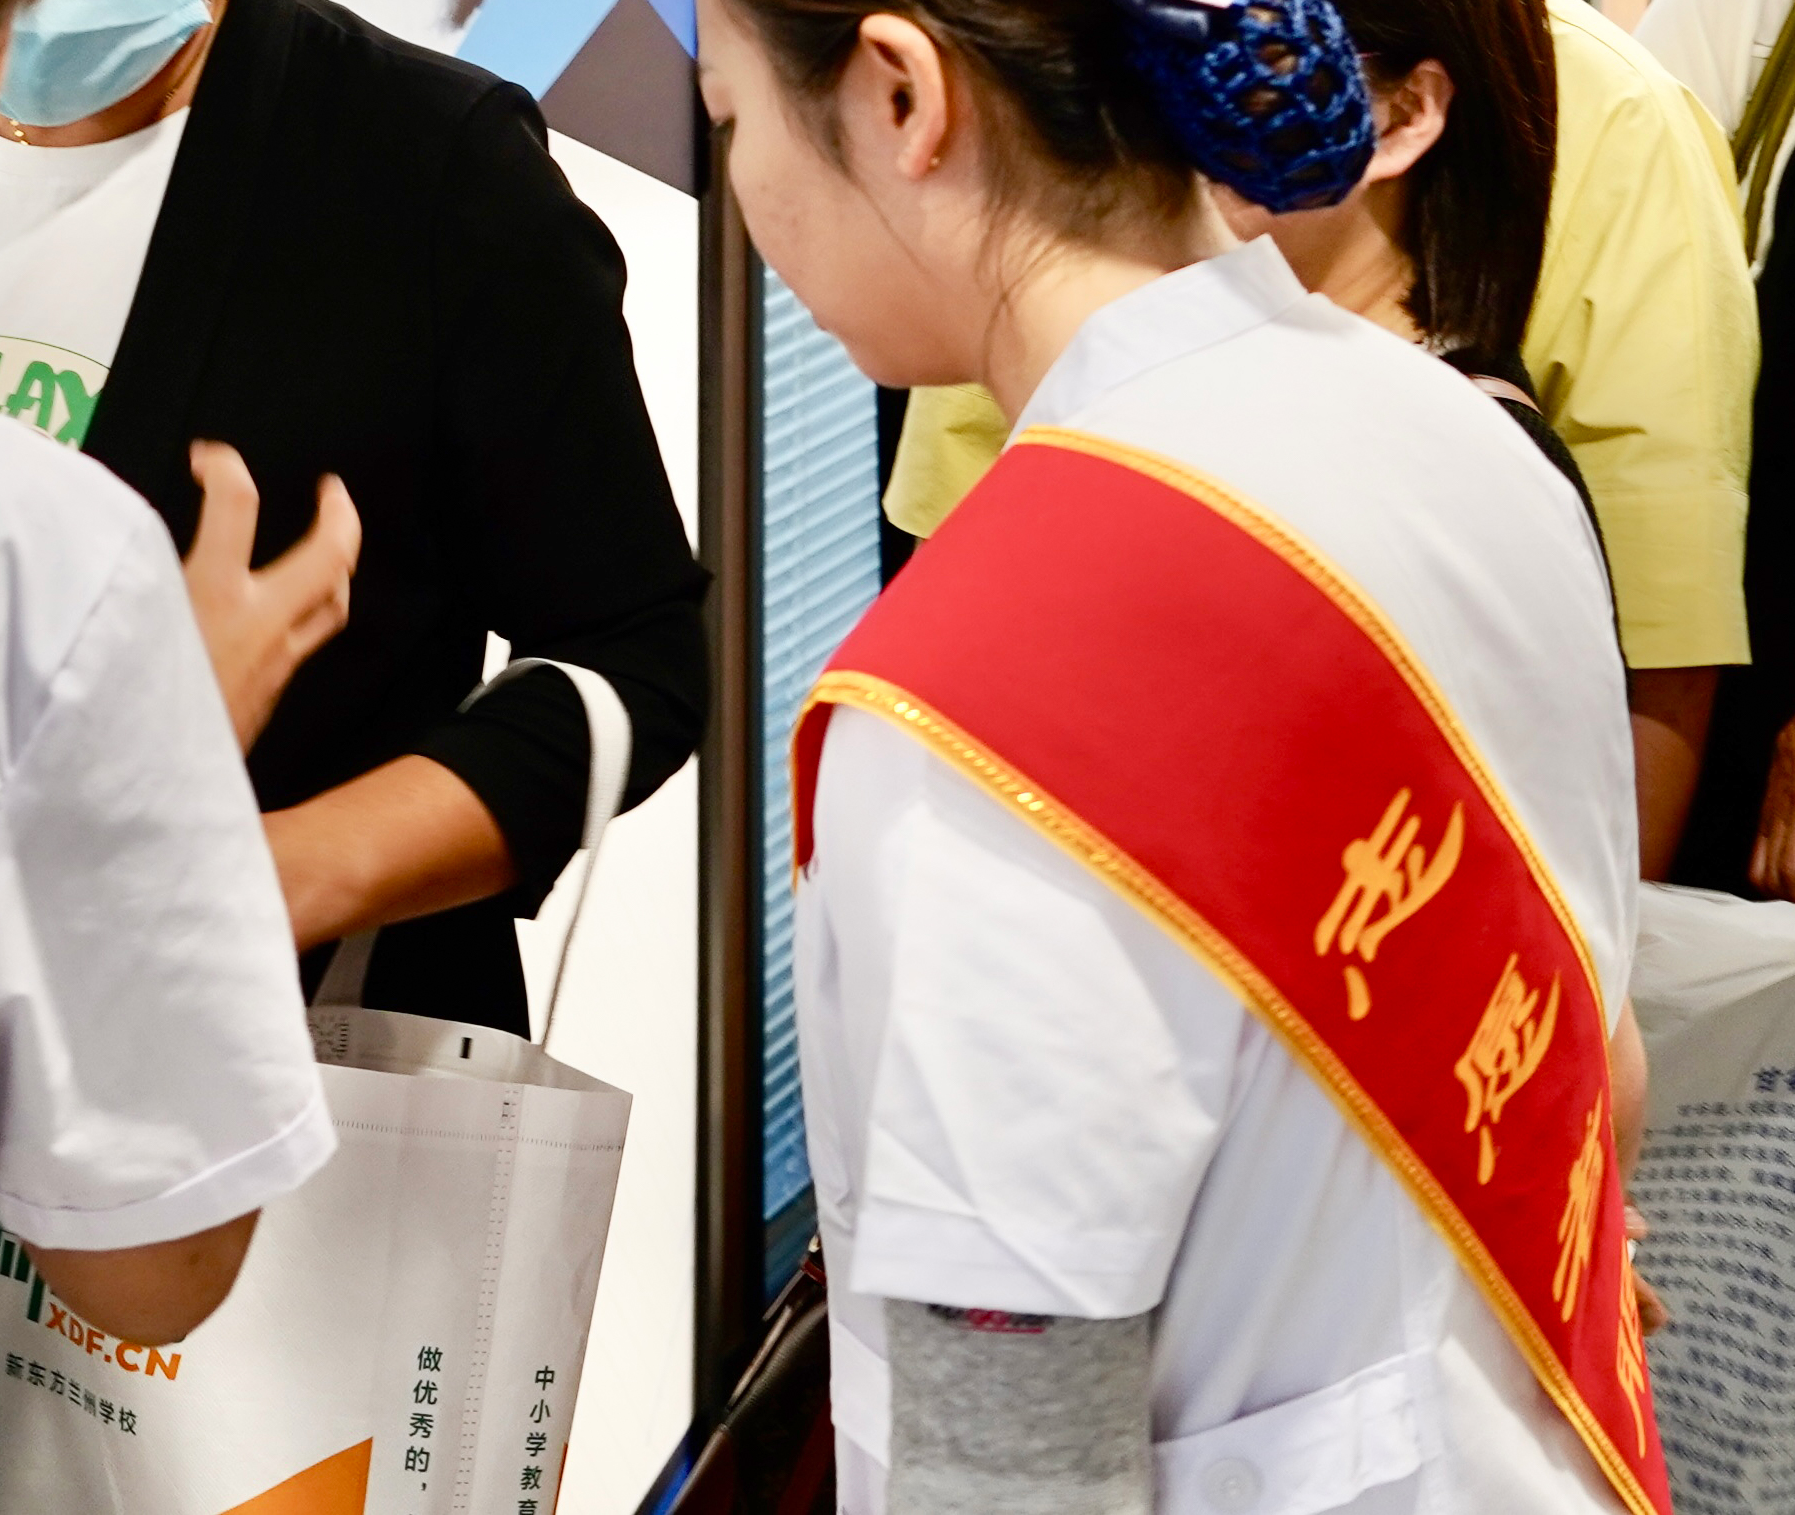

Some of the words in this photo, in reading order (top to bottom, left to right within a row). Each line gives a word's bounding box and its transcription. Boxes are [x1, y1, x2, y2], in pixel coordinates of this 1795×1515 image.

[45, 1301, 182, 1382] XDF.CN
[5, 1351, 138, 1437] 新东方兰州学校
